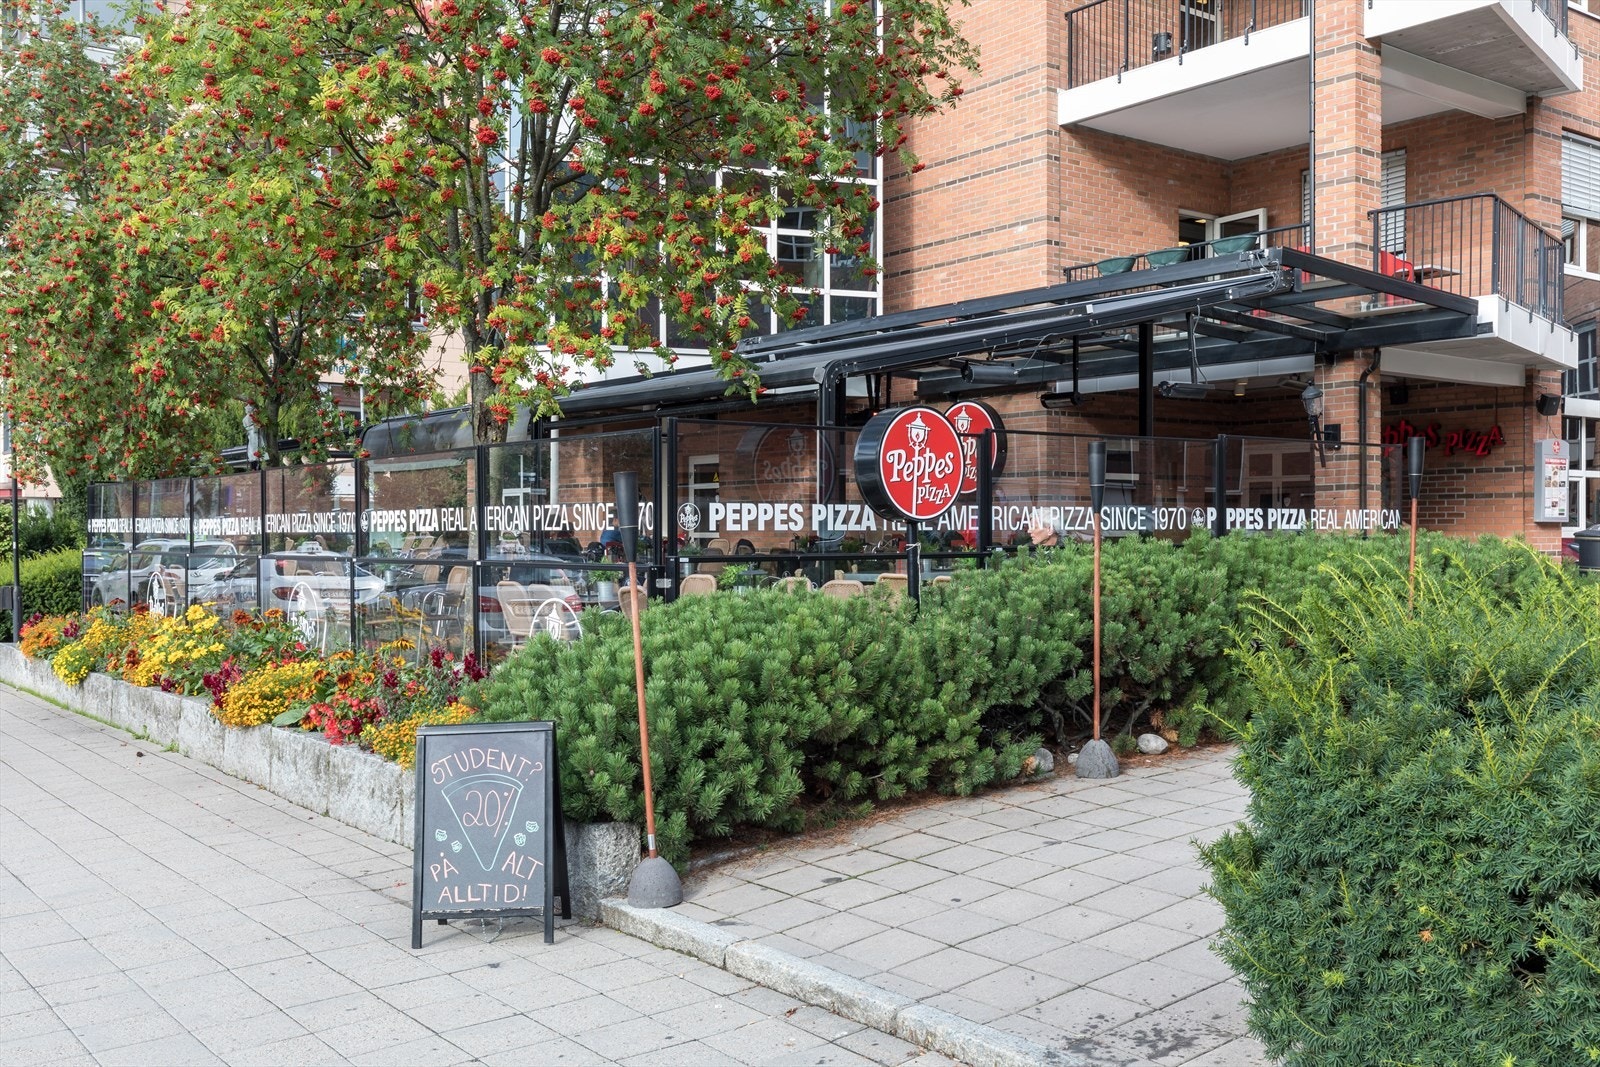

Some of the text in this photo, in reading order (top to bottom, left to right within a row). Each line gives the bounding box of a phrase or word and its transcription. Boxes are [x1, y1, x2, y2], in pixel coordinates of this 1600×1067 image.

[886, 448, 954, 483] Peppes
[917, 483, 952, 504] PIZZA
[91, 519, 106, 533] PEPPES
[107, 519, 119, 533] PIZZA
[130, 518, 152, 533] AERICAN
[152, 518, 165, 533] PIZZA
[165, 518, 178, 533] SINCE
[199, 518, 221, 535] PEPPES
[222, 517, 240, 535] PIZZA
[241, 517, 256, 535] REAL
[256, 514, 290, 535] AERICAN
[292, 513, 312, 533] PIZZA
[313, 512, 335, 533] SINCE
[371, 510, 407, 532] PEPPES
[409, 508, 439, 532] PIZZA
[441, 507, 467, 531] REAL
[469, 505, 529, 531] AERICAN
[533, 504, 570, 531] PIZZA
[572, 502, 614, 531] SINCE
[709, 503, 804, 531] PEPPES
[812, 504, 877, 531] PIZZA
[1050, 506, 1095, 530] PIZZA
[1100, 506, 1146, 531] SINCE
[1152, 507, 1186, 530] 1970
[1207, 507, 1263, 530] PPPES
[1268, 507, 1306, 530] PIZZA
[1311, 508, 1341, 529] REAL
[431, 748, 543, 785] STUDENT?
[463, 788, 515, 838] 20%
[430, 851, 544, 882] PÅ ALT
[438, 883, 528, 903] ALLTID!
